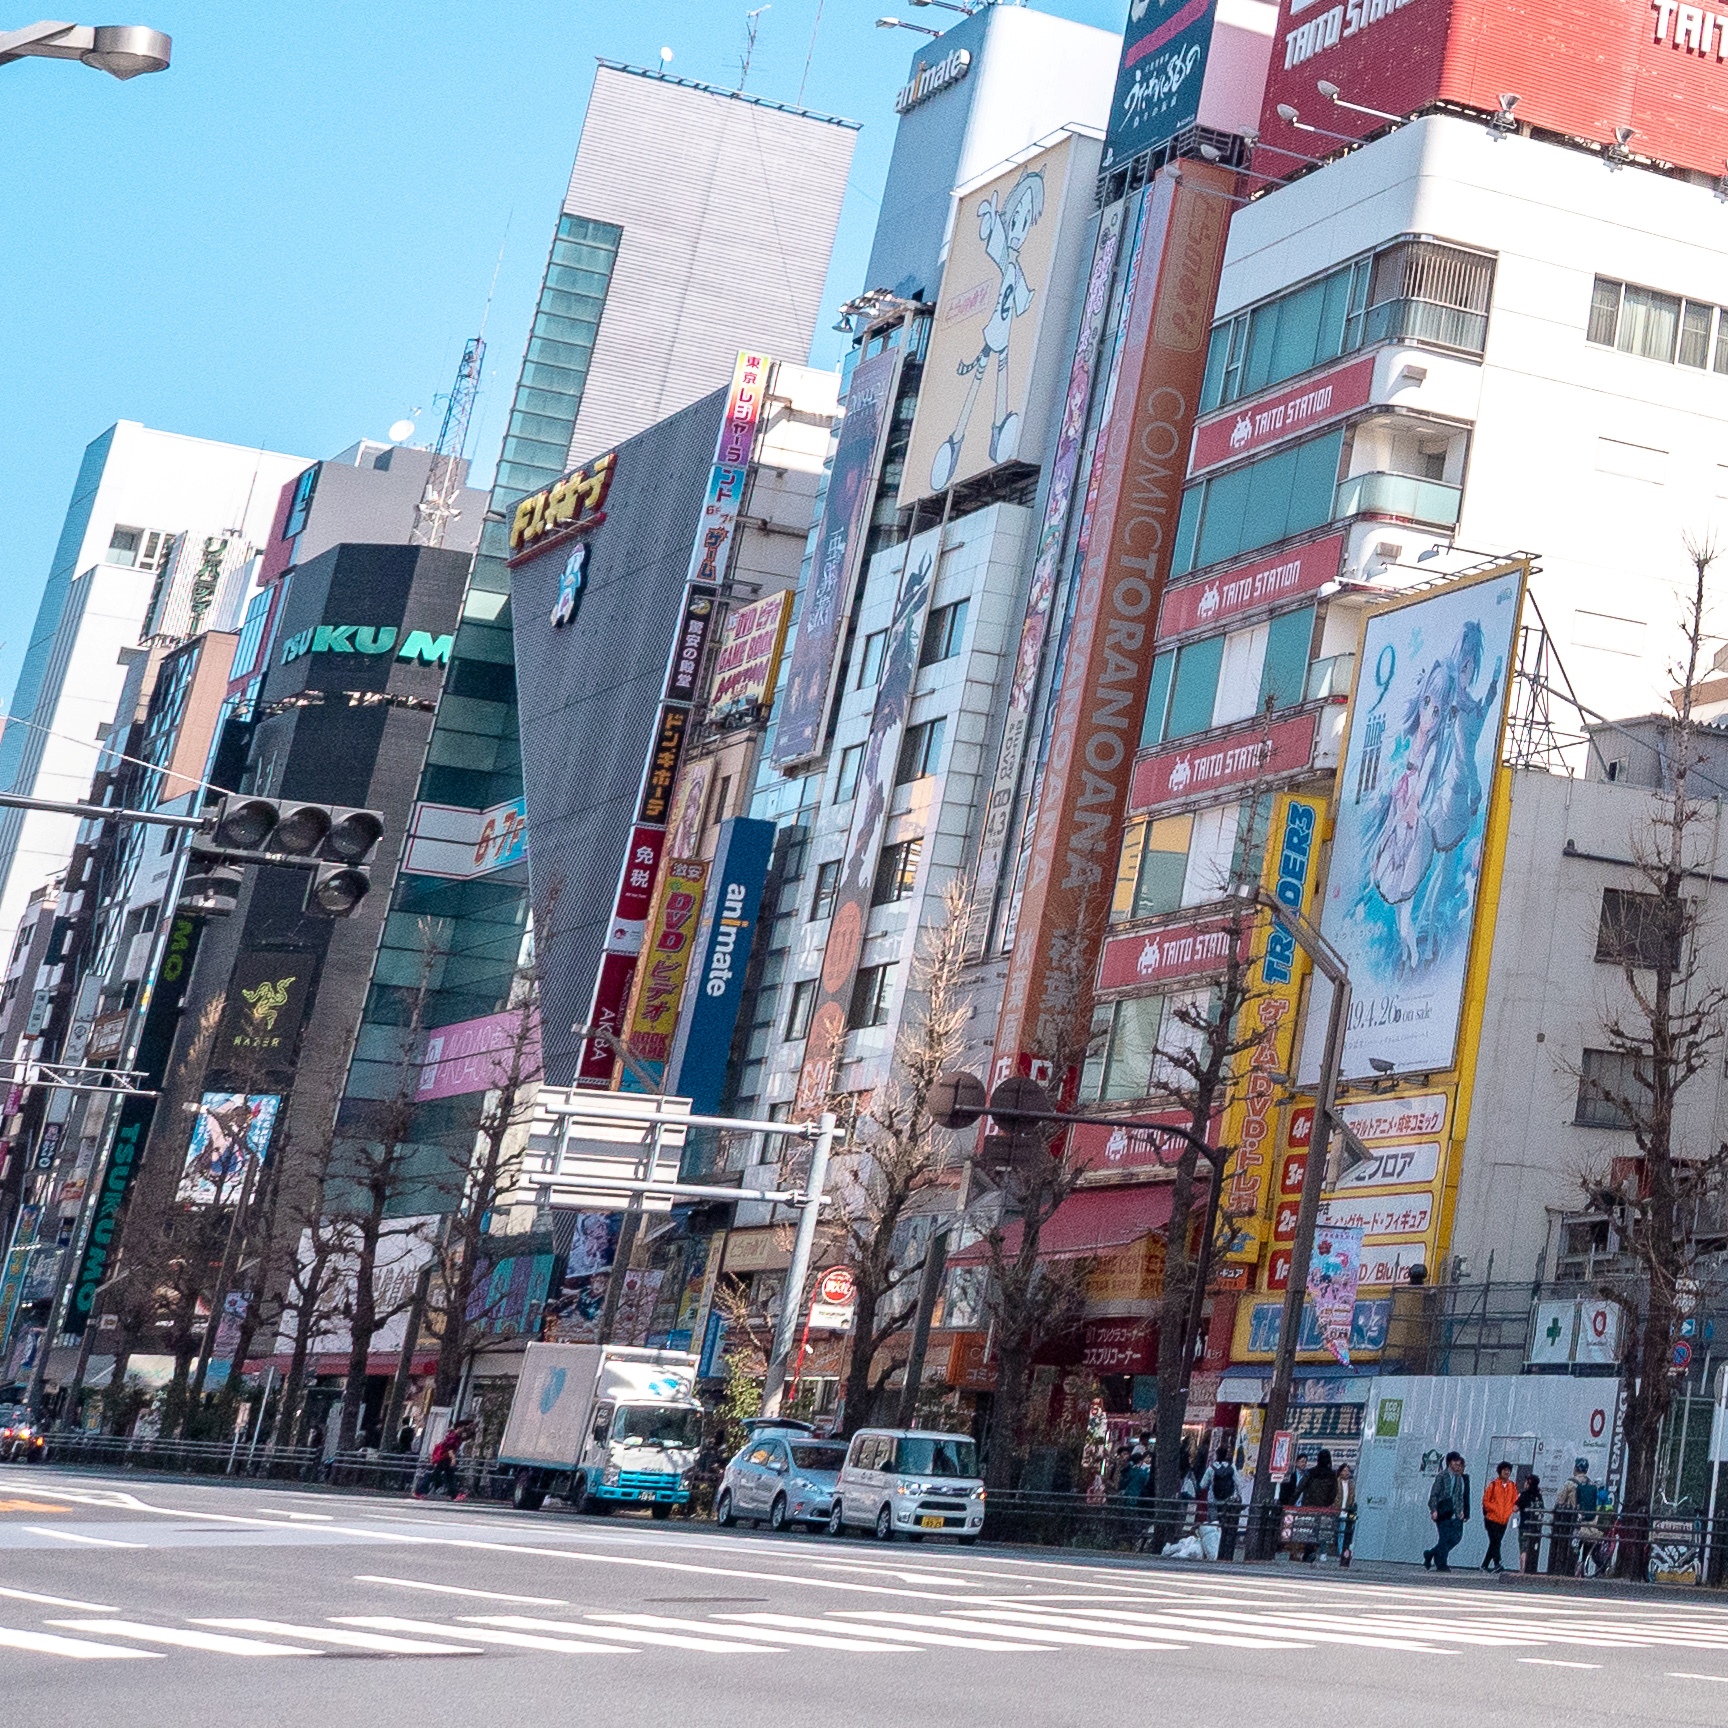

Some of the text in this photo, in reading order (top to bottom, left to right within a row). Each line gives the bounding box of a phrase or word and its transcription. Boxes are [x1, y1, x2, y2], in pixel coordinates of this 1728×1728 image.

[1253, 384, 1333, 440] TAITO STATION
[1116, 385, 1186, 554] COMIC
[1221, 559, 1302, 613] TAITO STATION
[1060, 550, 1160, 893] TORANOANA
[1192, 755, 1222, 784] TAITO
[629, 845, 655, 889] 免税
[706, 882, 748, 998] animate
[1162, 937, 1193, 967] TAITO
[1292, 1114, 1312, 1140] 4F
[75, 1122, 140, 1311] TSUKUMO
